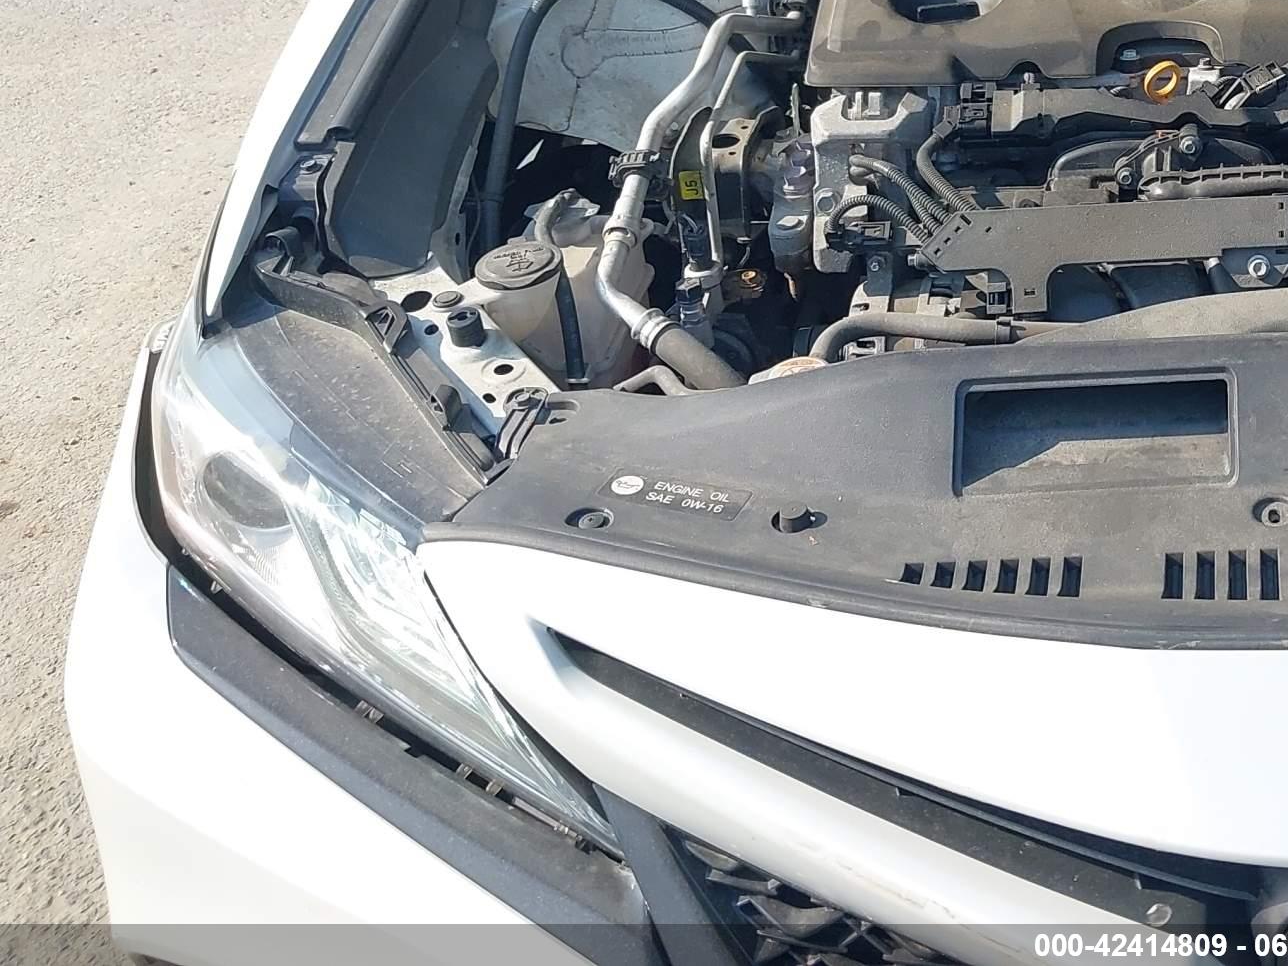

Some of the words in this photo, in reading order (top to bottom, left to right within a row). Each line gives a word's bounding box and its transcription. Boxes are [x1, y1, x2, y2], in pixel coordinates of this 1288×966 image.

[645, 491, 675, 505] SAE
[680, 498, 724, 514] 0W-16
[654, 481, 704, 498] ENGINE
[710, 491, 731, 503] OIL
